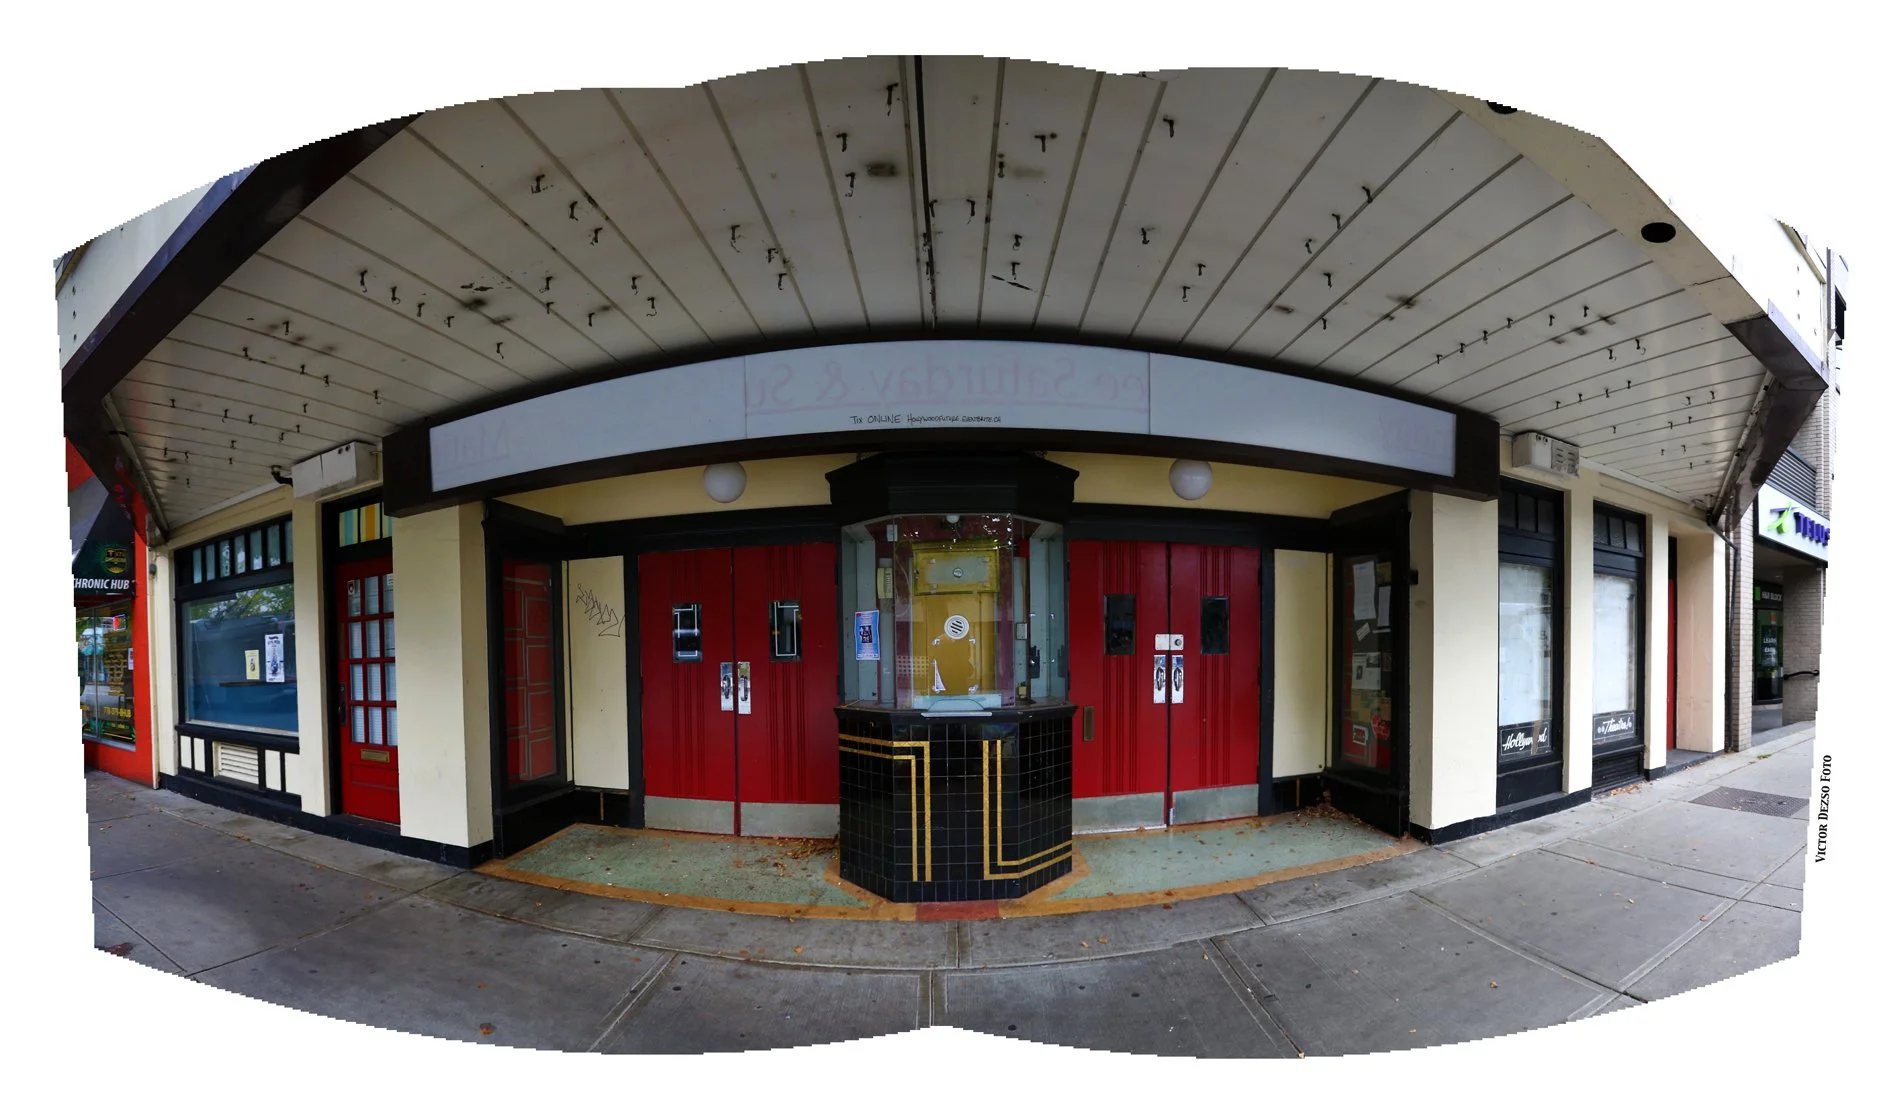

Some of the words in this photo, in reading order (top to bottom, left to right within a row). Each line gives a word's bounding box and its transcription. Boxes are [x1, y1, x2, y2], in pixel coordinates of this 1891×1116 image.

[867, 414, 901, 424] ONLINE
[74, 578, 110, 589] HRONIC
[110, 579, 130, 590] HUB
